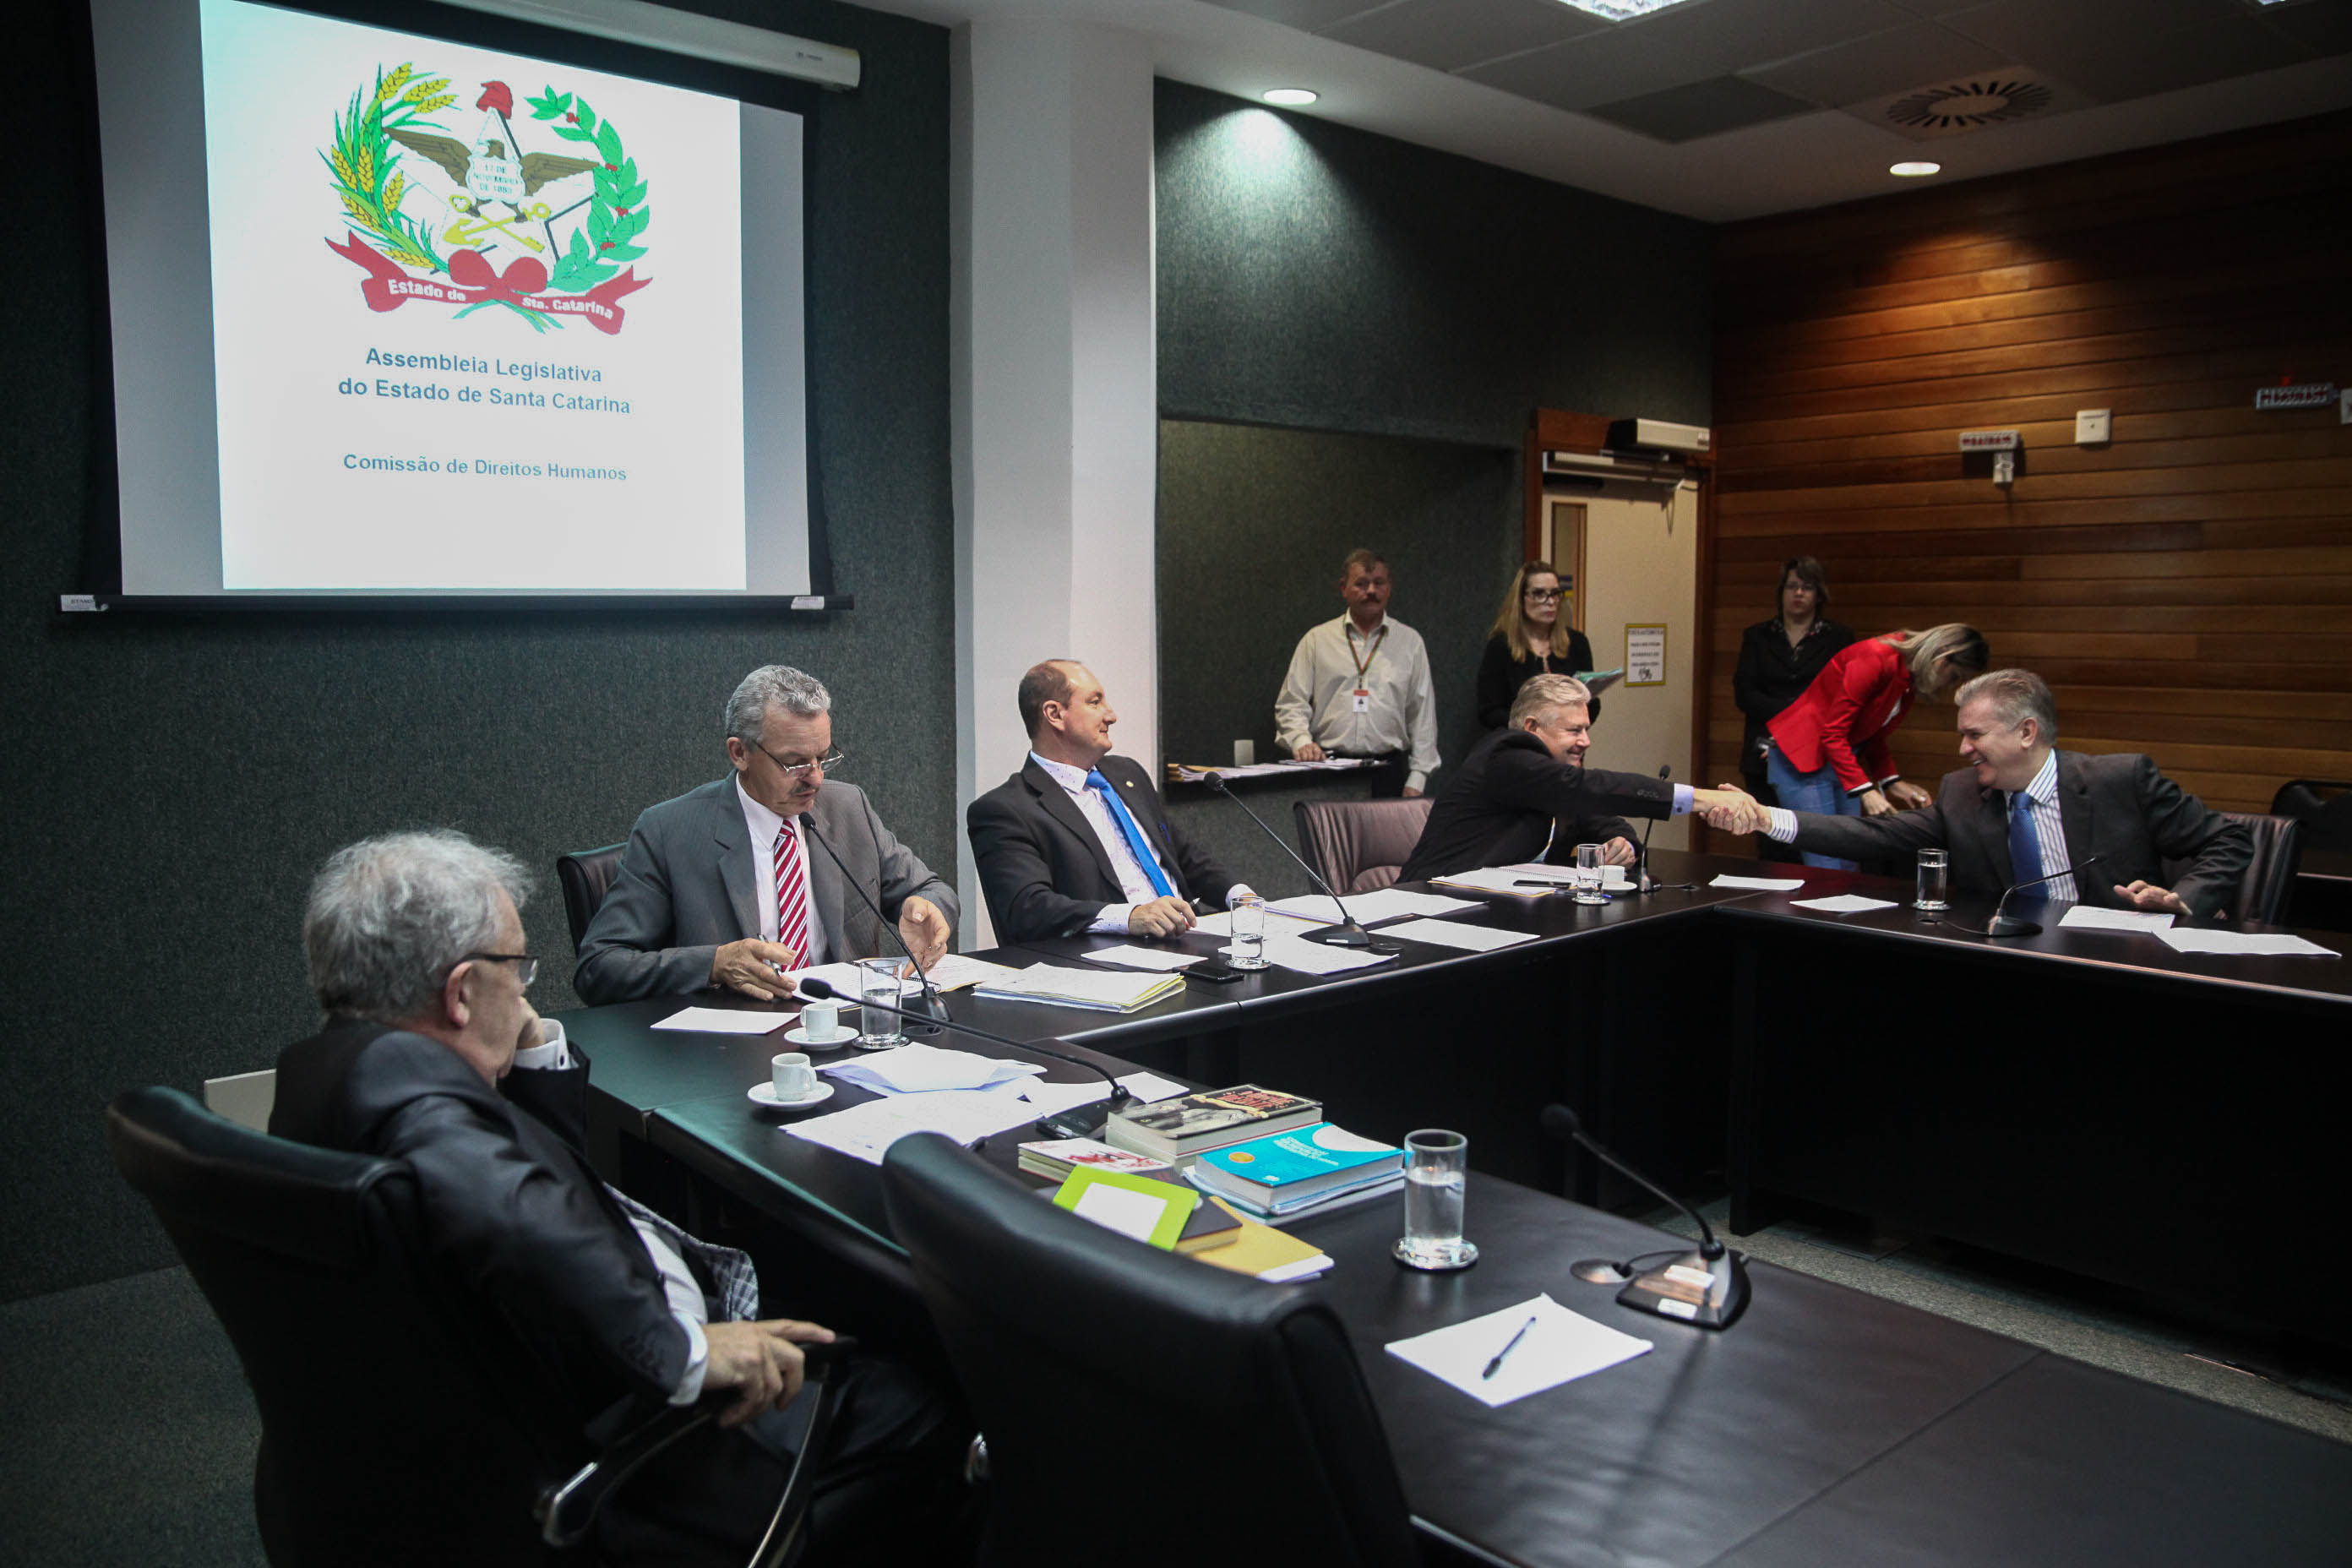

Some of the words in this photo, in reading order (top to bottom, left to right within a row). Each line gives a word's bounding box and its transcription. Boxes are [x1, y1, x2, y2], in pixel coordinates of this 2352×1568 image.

[388, 279, 443, 298] Estado
[521, 297, 549, 309] Sta.
[552, 299, 613, 320] Catarina
[365, 347, 488, 374] Assembleia
[496, 358, 602, 383] Legislativa
[338, 377, 368, 395] do
[375, 378, 450, 401] Estado
[457, 385, 482, 403] de
[489, 388, 546, 408] Santa
[552, 392, 630, 414] Catarina
[343, 453, 440, 473] Comissão
[445, 459, 469, 474] de
[475, 460, 542, 476] Direitos
[547, 463, 627, 481] Humanos
